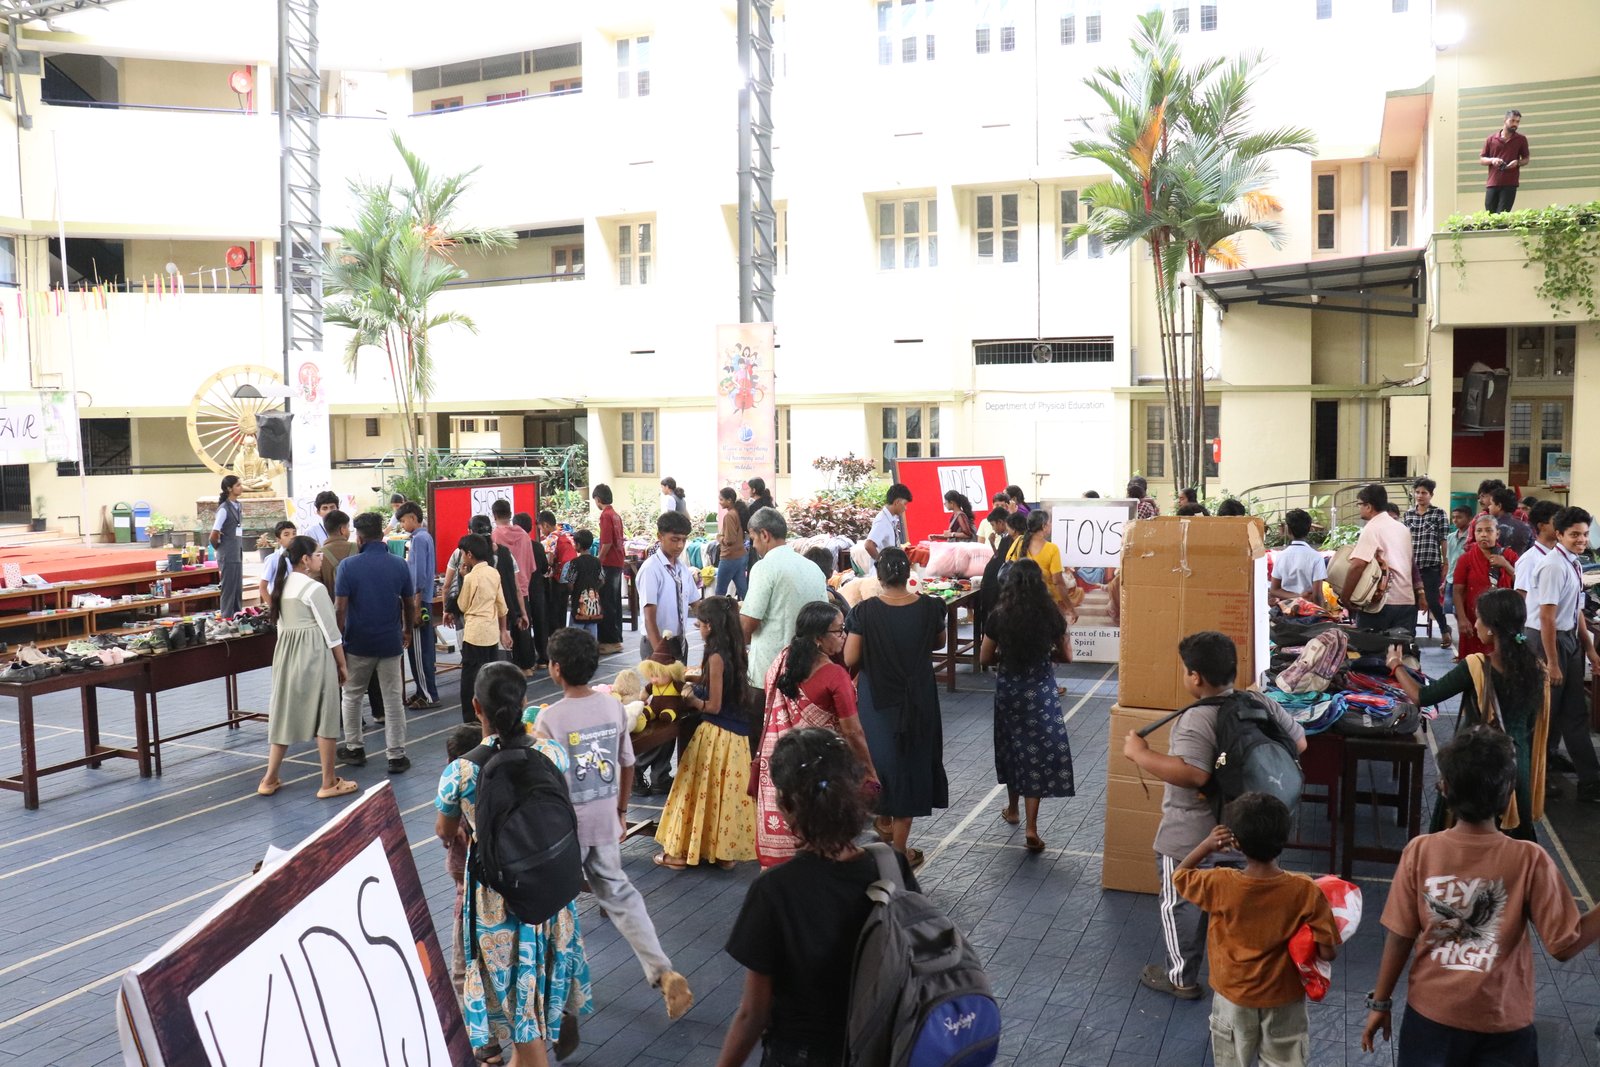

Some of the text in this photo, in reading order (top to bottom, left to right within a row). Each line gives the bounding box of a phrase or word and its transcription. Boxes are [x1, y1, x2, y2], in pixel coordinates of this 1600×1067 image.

[984, 400, 1105, 412] Department of Physical Education
[0, 408, 39, 439] AIR
[1058, 518, 1122, 556] TOYS
[1098, 630, 1111, 638] the
[1076, 649, 1093, 657] Zeal
[579, 727, 617, 741] Husqvarna
[1424, 875, 1482, 907] FLY
[1430, 940, 1500, 973] HIGH
